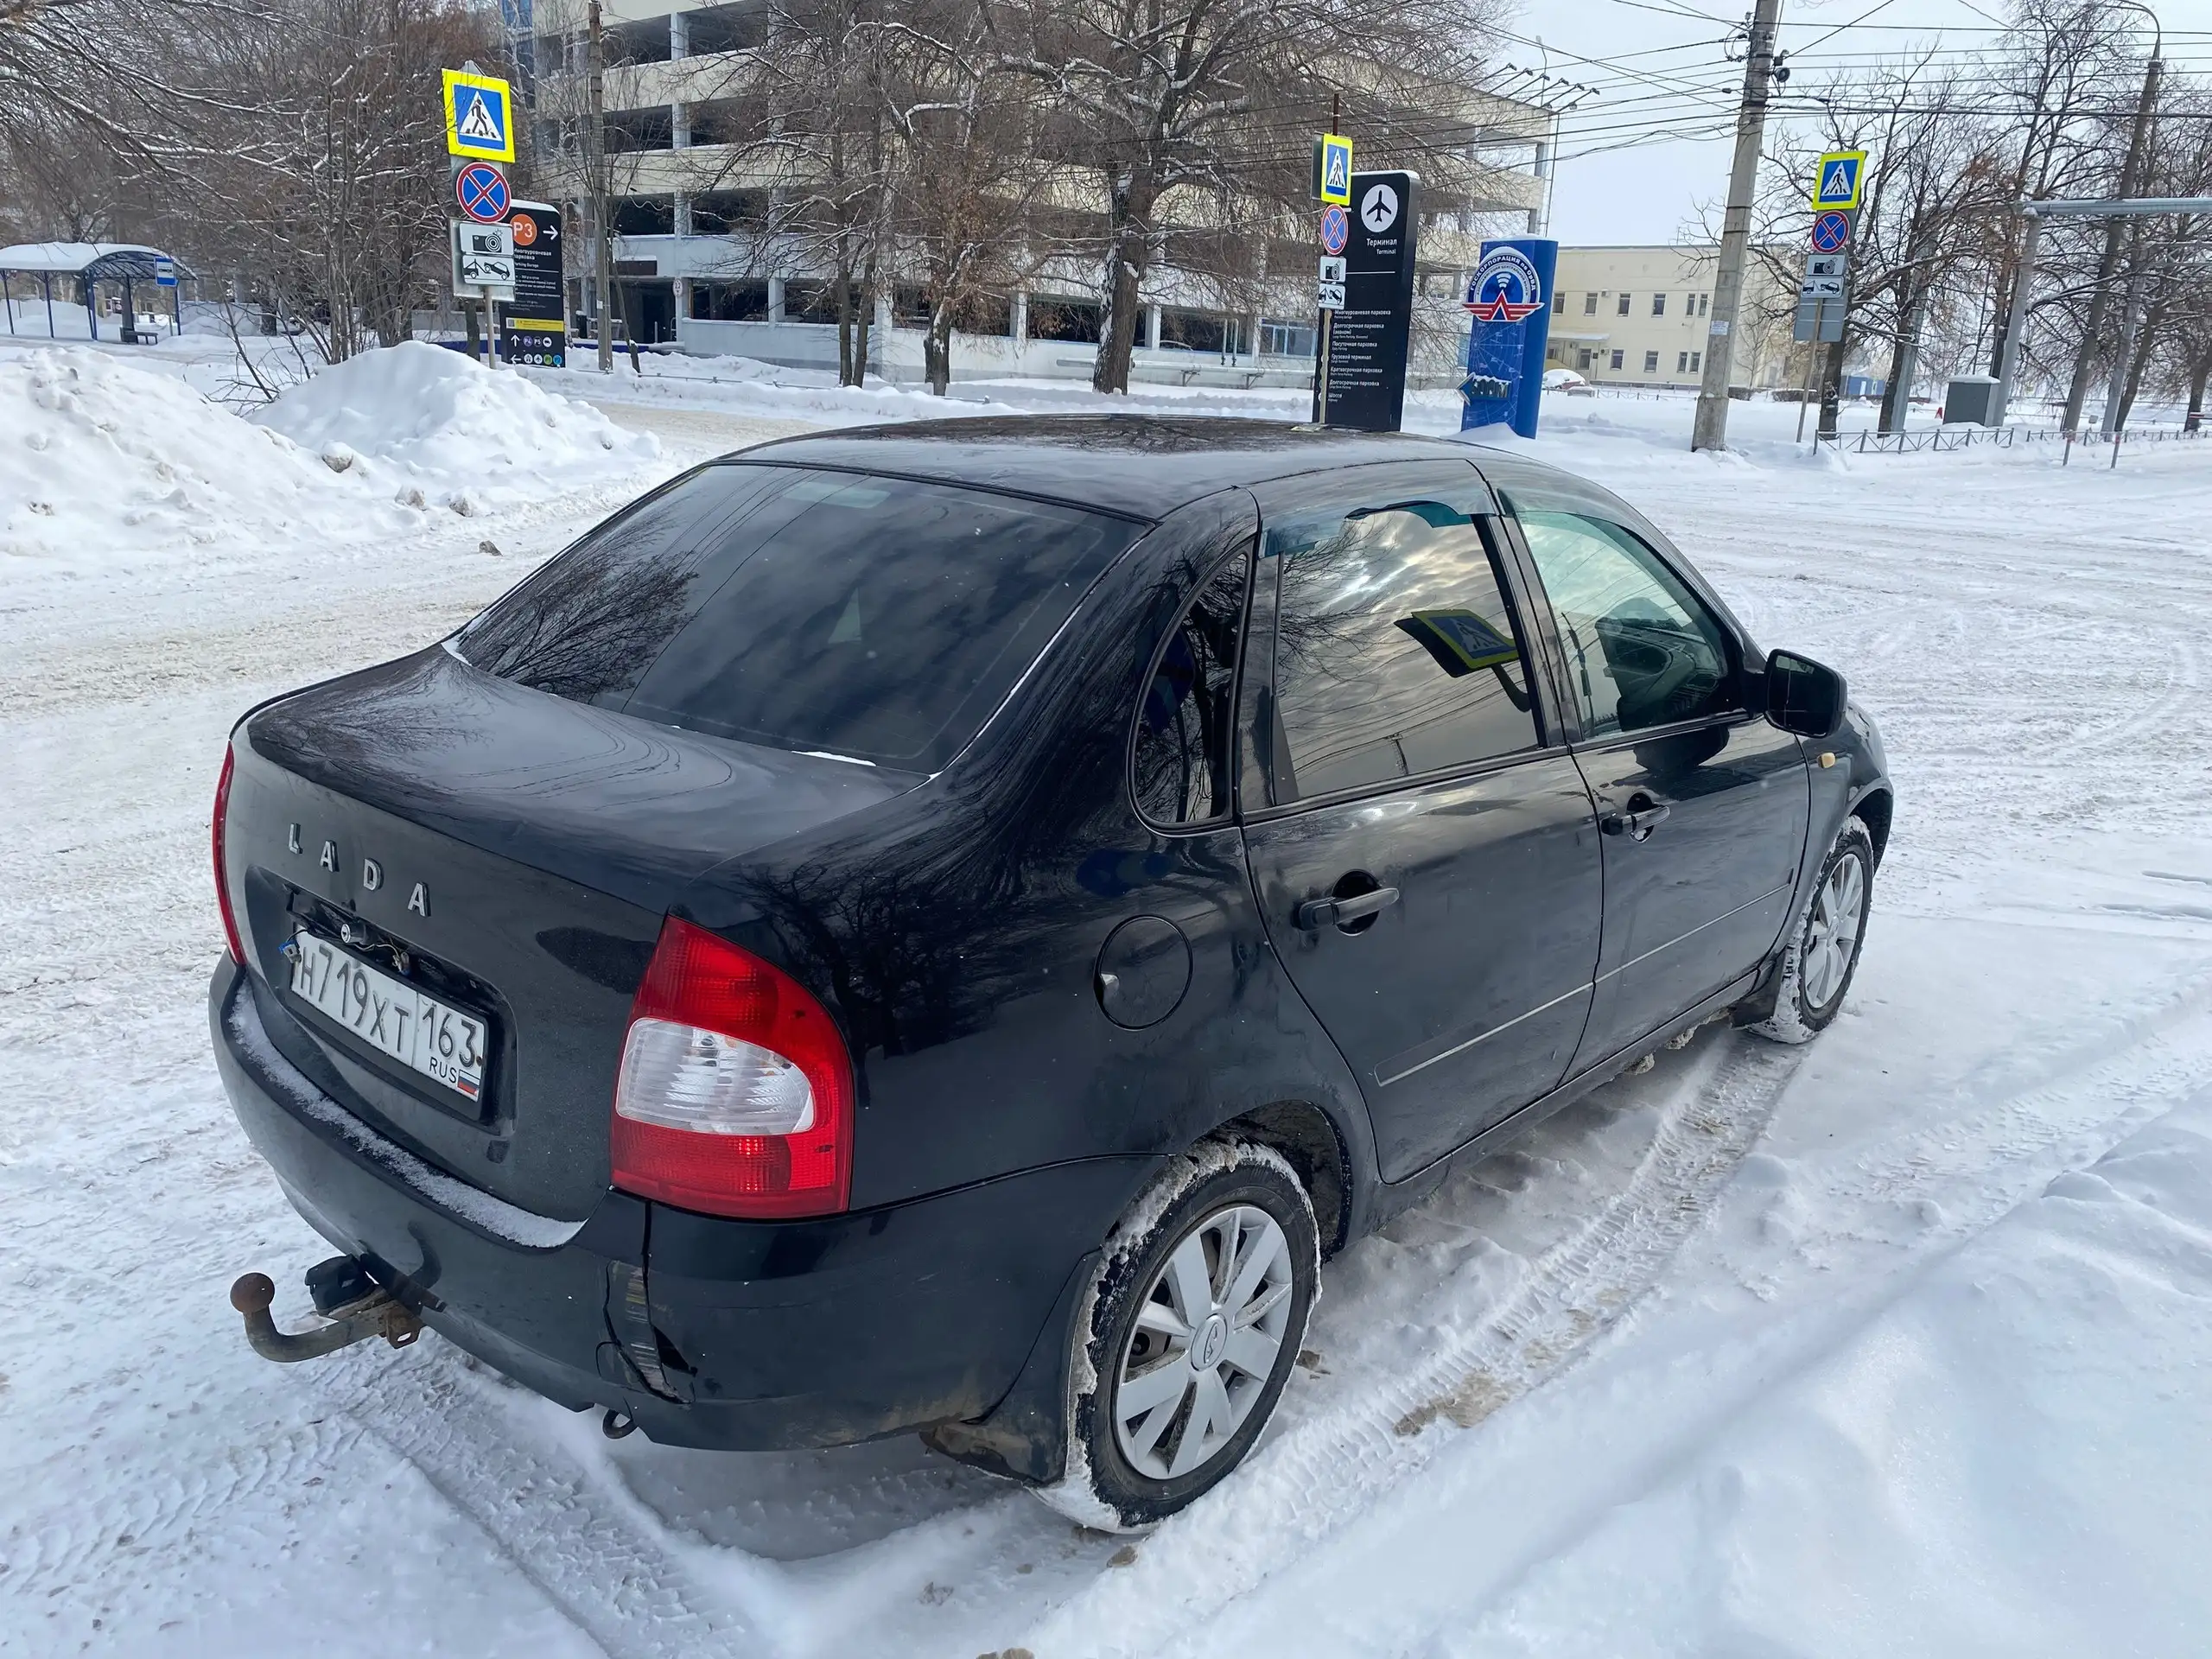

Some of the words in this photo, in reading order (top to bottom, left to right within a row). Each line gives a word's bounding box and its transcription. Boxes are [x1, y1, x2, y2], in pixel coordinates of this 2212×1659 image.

[513, 221, 533, 238] P3
[1366, 238, 1397, 247] Терминал
[1471, 255, 1521, 290] ГОСКОРПОРАЦИЯ
[289, 823, 432, 918] LADA
[300, 945, 410, 1053] Н719ХТ
[422, 1000, 477, 1068] 163
[429, 1056, 457, 1084] RUS
